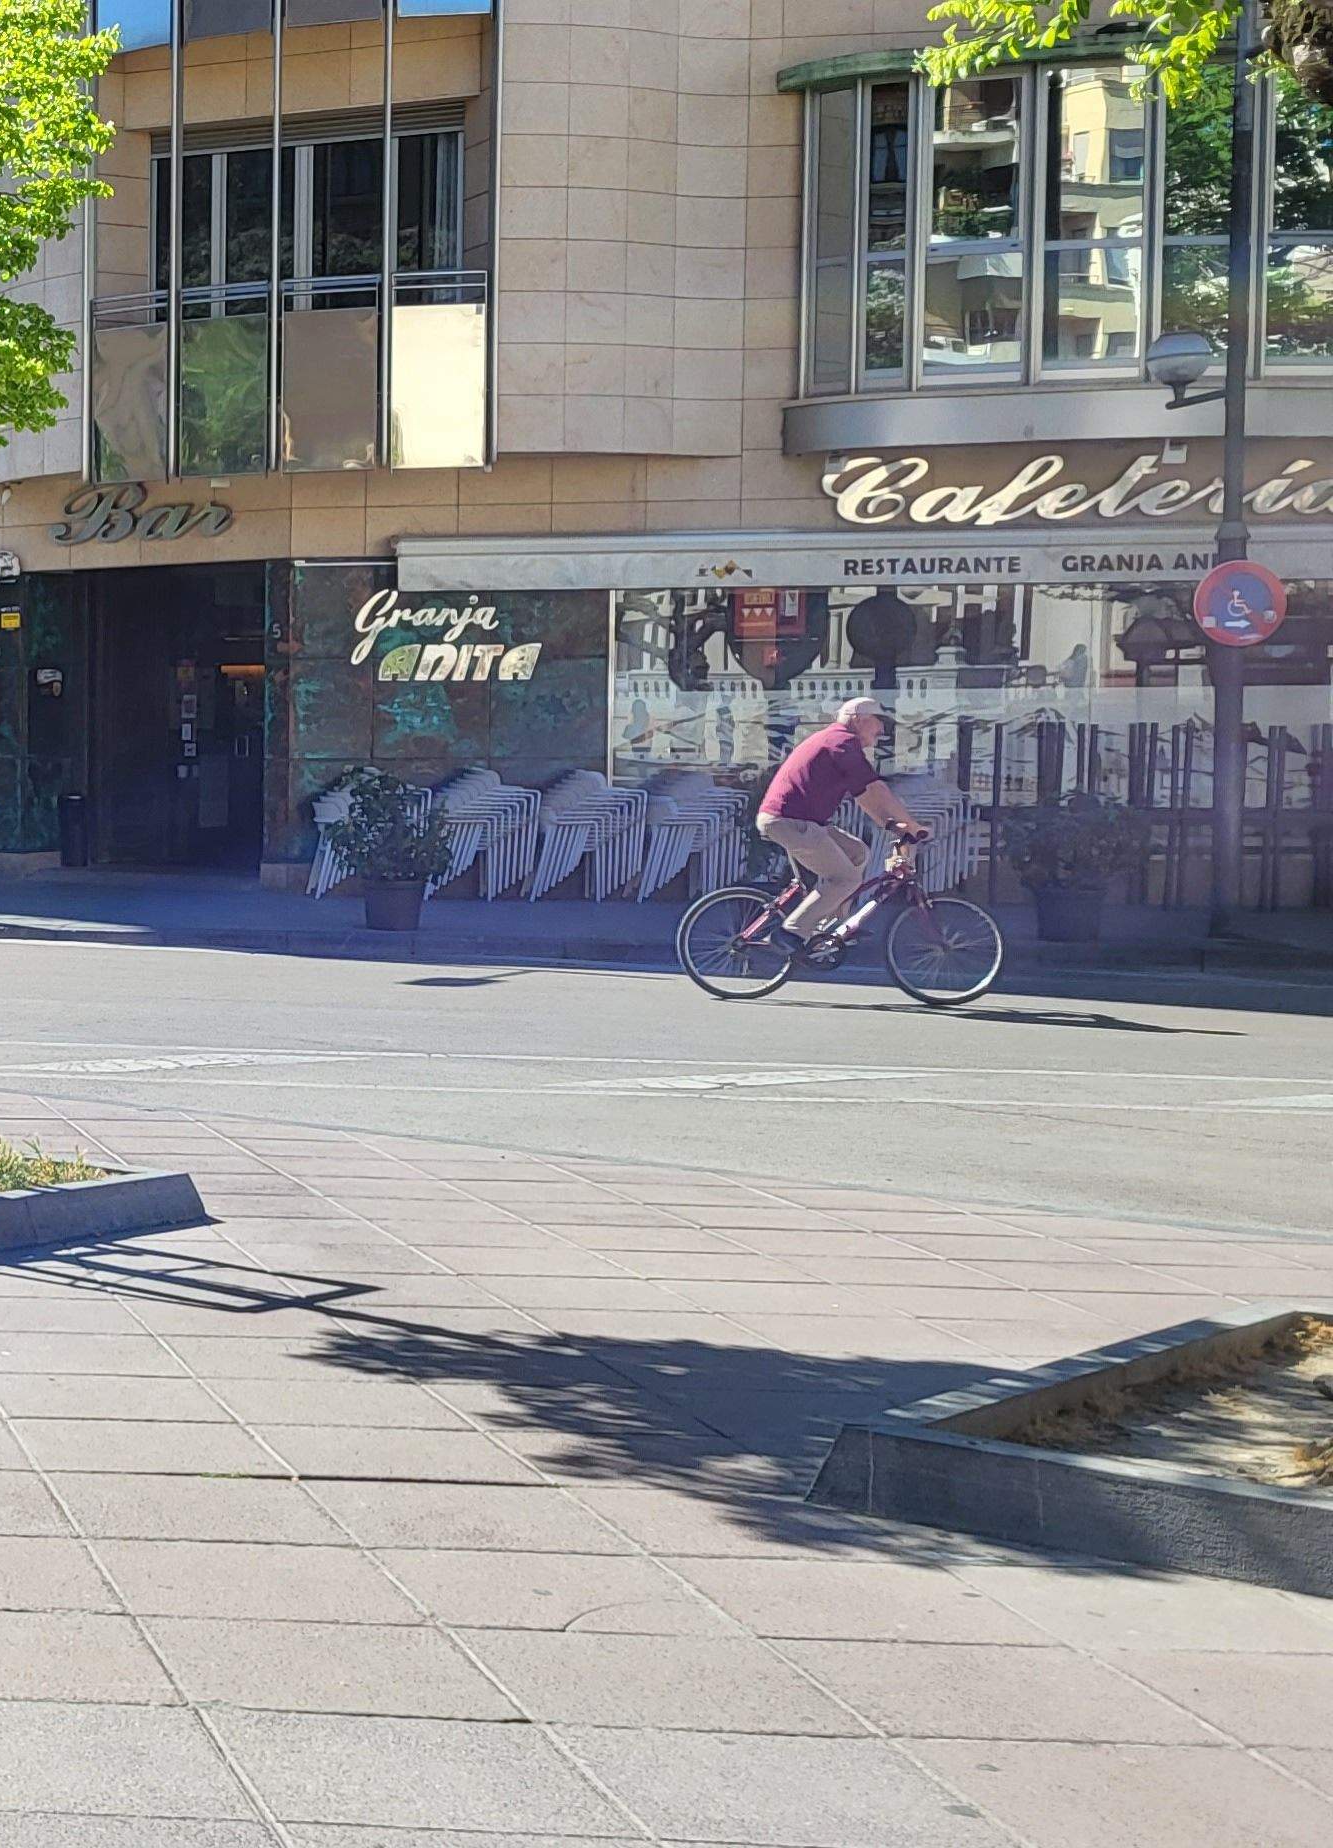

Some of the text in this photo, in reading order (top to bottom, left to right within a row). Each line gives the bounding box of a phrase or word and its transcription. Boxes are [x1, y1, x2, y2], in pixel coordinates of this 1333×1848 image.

[49, 482, 234, 546] Bar
[843, 552, 1220, 577] RESTAURANTE GRANJA ANI
[273, 623, 282, 639] 5
[350, 588, 500, 666] Granja
[378, 642, 543, 682] ANITA
